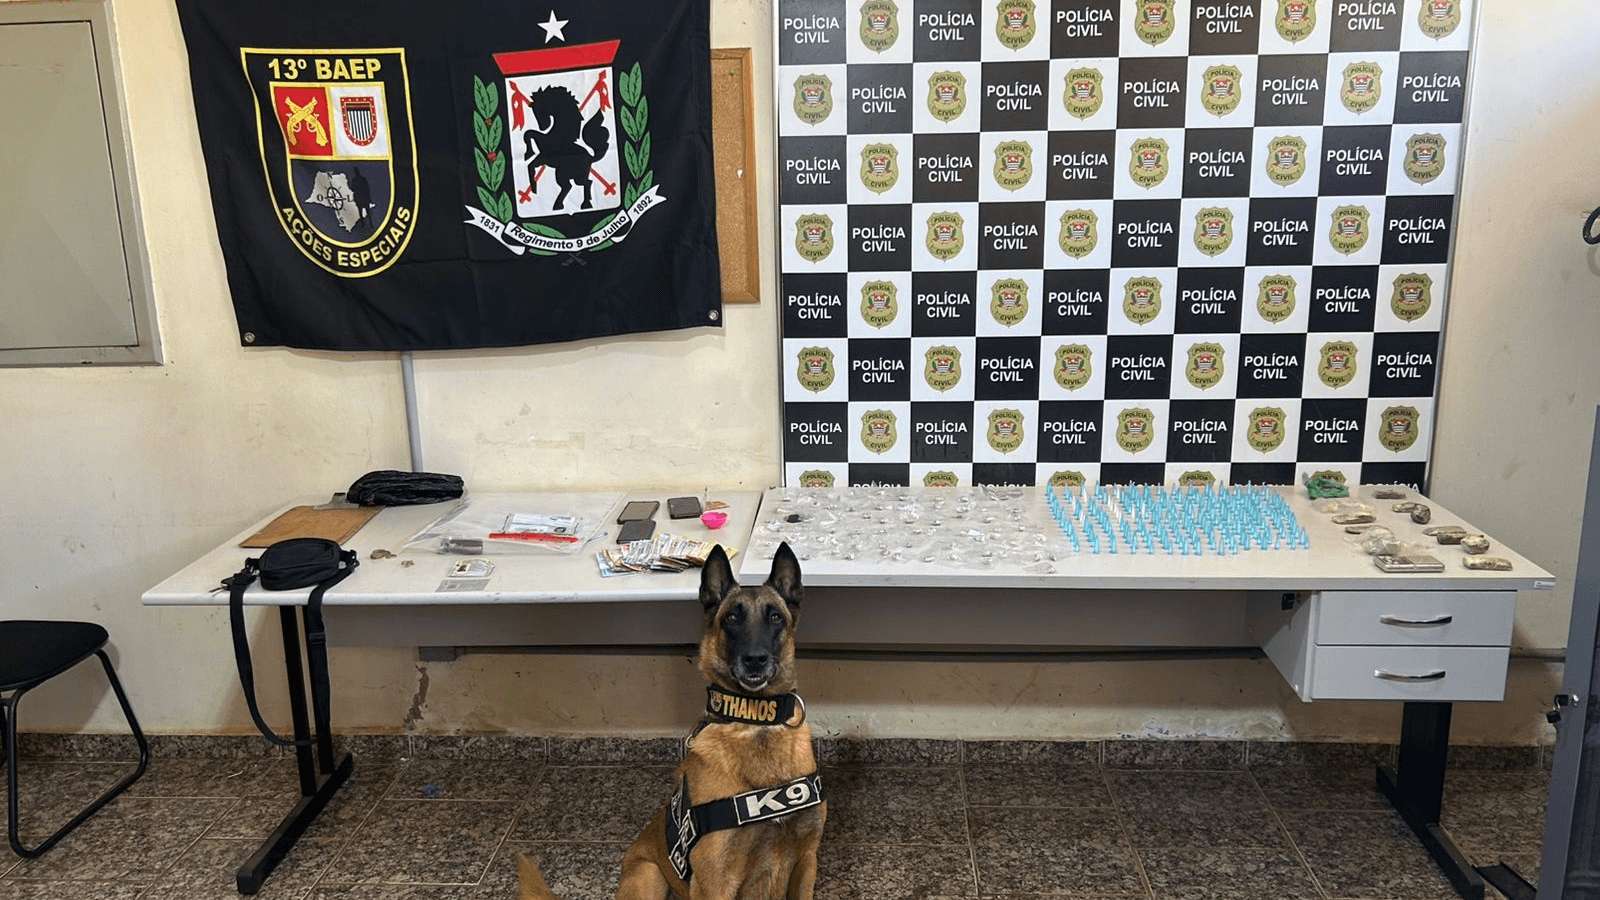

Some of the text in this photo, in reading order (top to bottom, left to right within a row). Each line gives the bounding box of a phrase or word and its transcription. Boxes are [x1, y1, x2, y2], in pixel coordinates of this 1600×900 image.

[1197, 3, 1253, 18] POLÍCIA
[1339, 0, 1396, 15] POLÍCIA
[920, 11, 974, 26] POLÍCIA
[1057, 7, 1113, 22] POLÍCIA
[785, 15, 839, 29] POLÍCIA
[1207, 21, 1242, 33] CIVIL
[1348, 18, 1384, 30] CIVIL
[930, 29, 964, 40] CIVIL
[1067, 25, 1102, 36] CIVIL
[795, 32, 829, 43] CIVIL
[314, 58, 381, 80] BAEP
[1124, 79, 1179, 93] POLÍCIA
[1263, 76, 1318, 91] POLÍCIA
[1403, 73, 1461, 88] POLÍCIA
[853, 85, 906, 99] POLÍCIA
[987, 82, 1042, 96] POLÍCIA
[1134, 96, 1168, 107] CIVIL
[1272, 93, 1307, 104] CIVIL
[1413, 90, 1448, 102] CIVIL
[862, 102, 896, 113] CIVIL
[997, 99, 1031, 110] CIVIL
[1053, 152, 1108, 166] POLÍCIA
[1190, 149, 1245, 163] POLÍCIA
[1327, 147, 1383, 161] POLÍCIA
[787, 157, 840, 171] POLÍCIA
[919, 154, 972, 168] POLÍCIA
[1063, 168, 1097, 179] CIVIL
[1199, 166, 1233, 177] CIVIL
[1337, 164, 1371, 175] CIVIL
[797, 173, 830, 184] CIVIL
[929, 171, 962, 182] CIVIL
[479, 195, 653, 250] 1831 Regimento 9 de Julho 1892
[1119, 220, 1172, 234] POLÍCIA
[1254, 218, 1308, 232] POLÍCIA
[1390, 216, 1445, 230] POLÍCIA
[853, 225, 905, 238] POLÍCIA
[985, 223, 1038, 236] POLÍCIA
[282, 207, 411, 267] AÇÕES ESPECIAIS
[1128, 237, 1162, 247] CIVIL
[1263, 235, 1297, 245] CIVIL
[1399, 233, 1433, 243] CIVIL
[863, 241, 895, 251] CIVIL
[994, 239, 1027, 249] CIVIL
[918, 291, 970, 304] POLÍCIA
[1049, 289, 1102, 302] POLÍCIA
[1182, 287, 1236, 301] POLÍCIA
[1317, 286, 1370, 299] POLÍCIA
[789, 293, 841, 306] POLÍCIA
[799, 308, 831, 318] CIVIL
[927, 307, 960, 317] CIVIL
[1058, 305, 1091, 315] CIVIL
[1192, 303, 1225, 314] CIVIL
[1326, 302, 1359, 312] CIVIL
[853, 358, 904, 370] POLÍCIA
[981, 356, 1033, 369] POLÍCIA
[1112, 355, 1165, 367] POLÍCIA
[1245, 353, 1297, 366] POLÍCIA
[1378, 352, 1432, 365] POLÍCIA
[863, 373, 894, 382] CIVIL
[991, 371, 1023, 381] CIVIL
[1121, 370, 1154, 380] CIVIL
[1254, 369, 1287, 379] CIVIL
[1387, 368, 1421, 378] CIVIL
[791, 420, 842, 432] POLÍCIA
[917, 420, 967, 432] POLÍCIA
[1044, 419, 1096, 432] POLÍCIA
[1174, 419, 1226, 431] POLÍCIA
[1306, 418, 1358, 430] POLÍCIA
[800, 435, 832, 444] CIVIL
[926, 435, 957, 444] CIVIL
[1053, 434, 1085, 444] CIVIL
[1183, 434, 1216, 443] CIVIL
[1314, 433, 1347, 443] CIVIL
[723, 694, 777, 721] THANOS
[745, 783, 811, 818] K9
